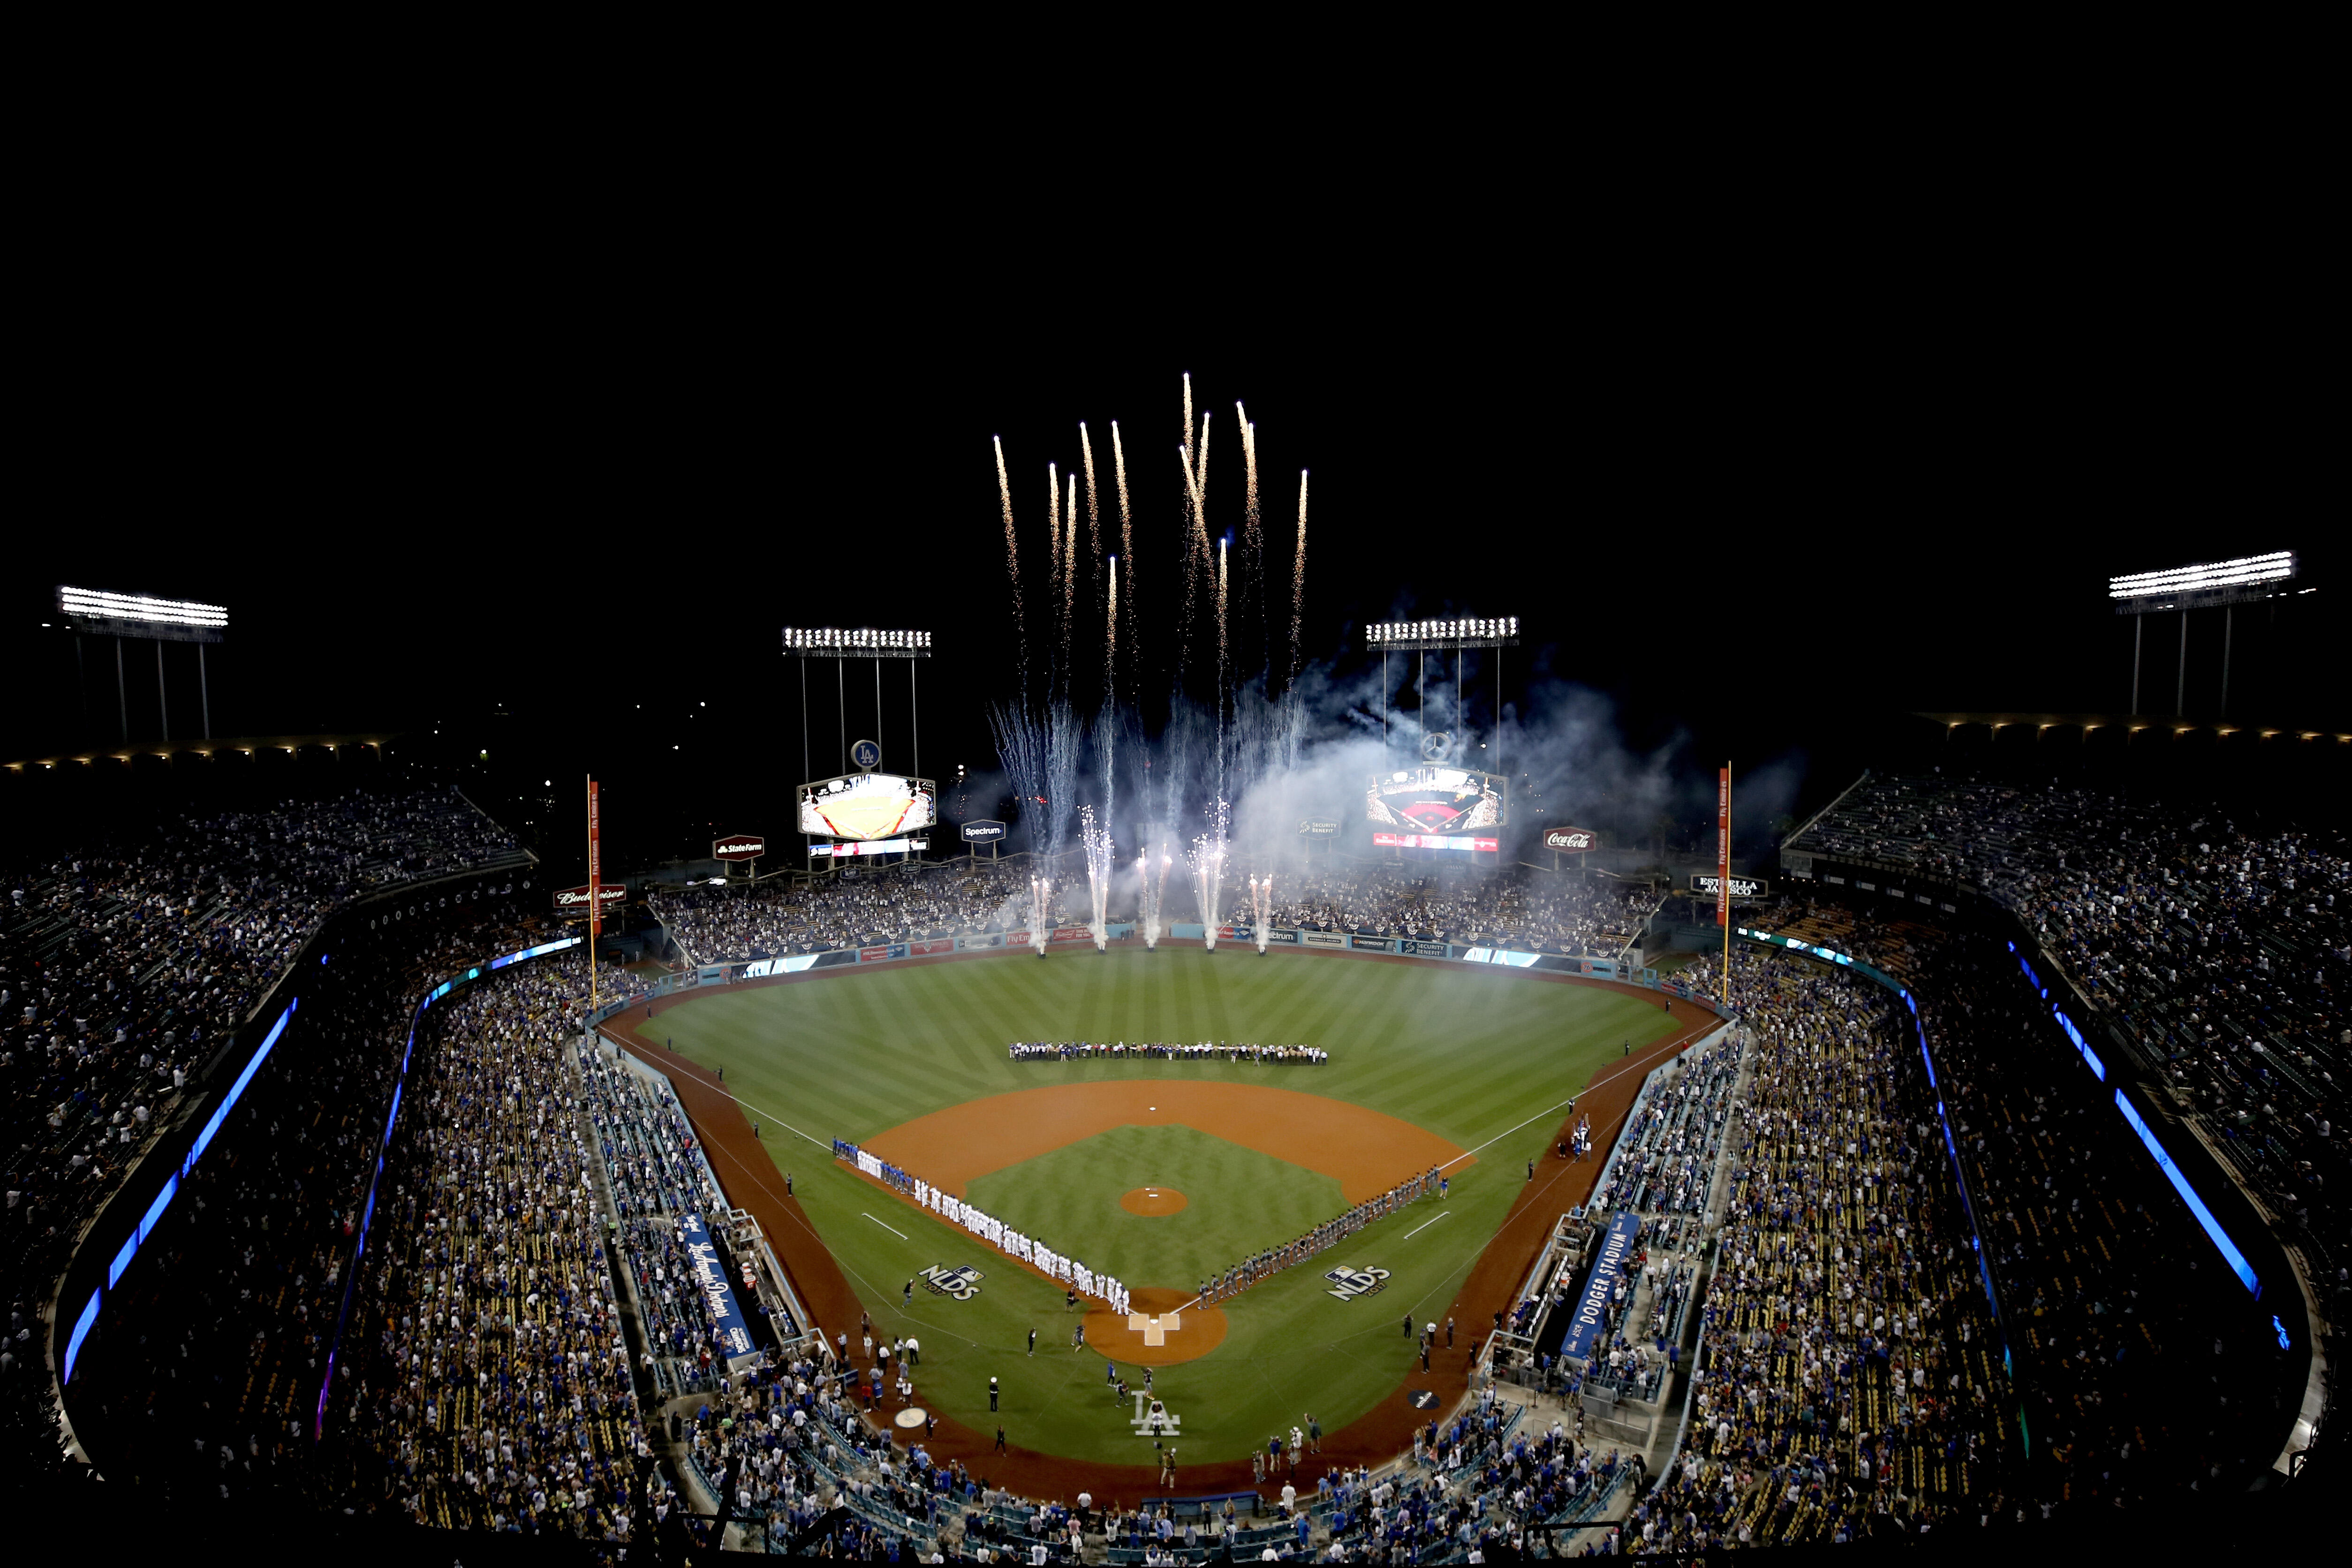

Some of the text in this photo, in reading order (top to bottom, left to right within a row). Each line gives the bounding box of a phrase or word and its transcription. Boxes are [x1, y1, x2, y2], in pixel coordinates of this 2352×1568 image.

[860, 745, 874, 764] LA
[965, 828, 1000, 837] Spectrum
[1547, 833, 1591, 848] Coca-Cola
[1700, 877, 1757, 889] ESTELLA
[1705, 885, 1752, 896] JASCO
[557, 889, 624, 905] Budeiser
[1268, 932, 1293, 940] ectrum
[688, 1242, 713, 1260] Los
[695, 1257, 718, 1289] Angeles
[1580, 1233, 1627, 1325] DODGER STADIUM
[918, 1264, 981, 1301] NLDS
[1326, 1265, 1391, 1302] NLDS
[1365, 1282, 1386, 1296] 2017
[704, 1282, 730, 1318] Dodgers
[1130, 1391, 1180, 1436] LA
